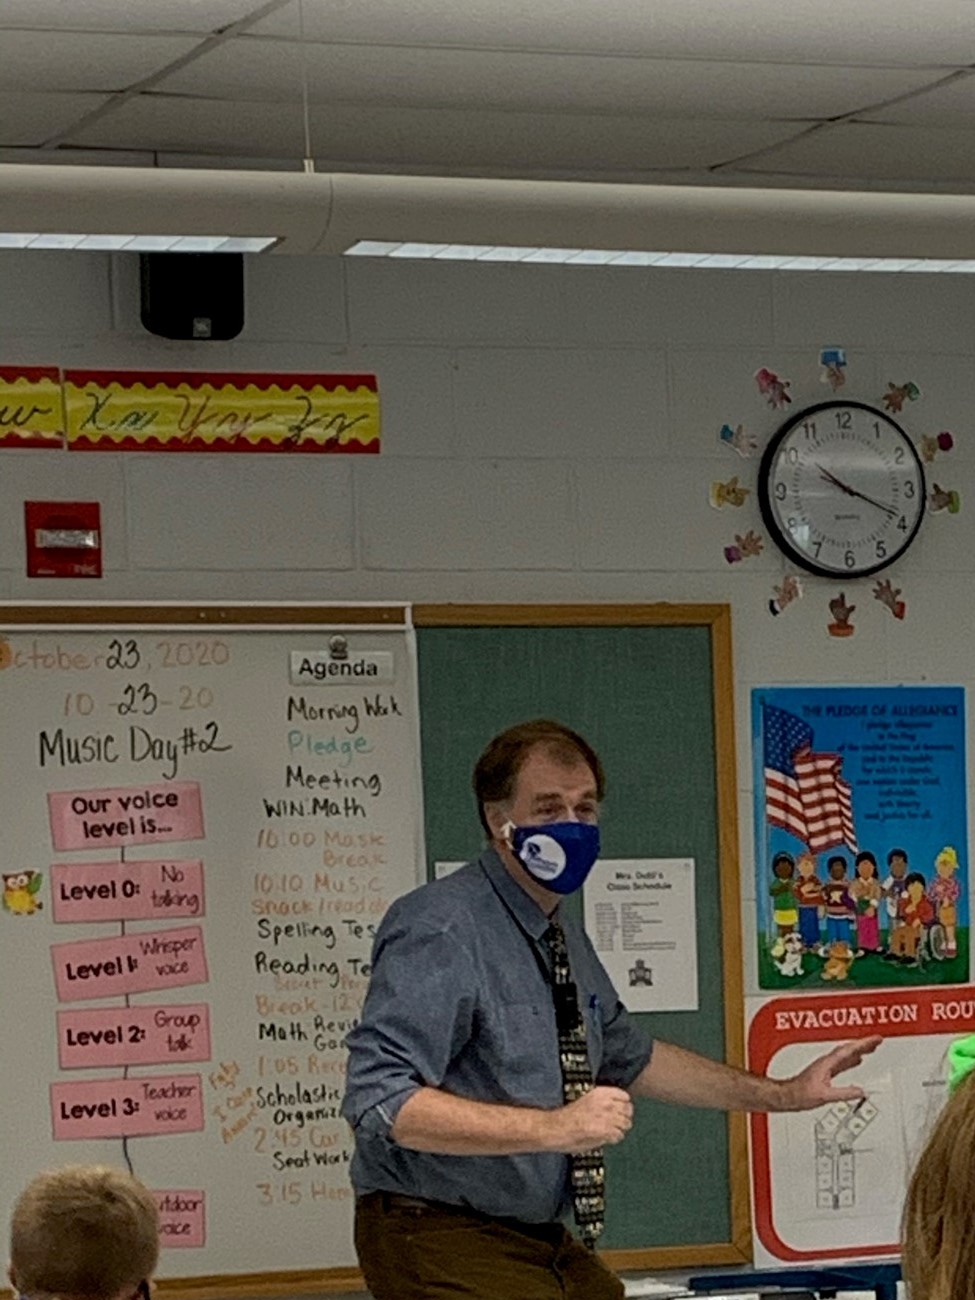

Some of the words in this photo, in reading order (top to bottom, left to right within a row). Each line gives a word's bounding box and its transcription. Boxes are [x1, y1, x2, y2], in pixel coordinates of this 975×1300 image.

[803, 422, 817, 440] 11
[835, 411, 852, 430] 12
[873, 421, 880, 439] 1
[780, 446, 798, 465] 10
[893, 446, 905, 465] 2
[775, 482, 787, 501] 9
[903, 480, 915, 498] 3
[896, 515, 908, 533] 4
[812, 541, 822, 559] 7
[844, 550, 856, 568] 6
[875, 540, 887, 559] 5
[157, 641, 230, 668] 2020
[299, 658, 378, 680] Agenda
[287, 696, 360, 734] Morning
[892, 704, 958, 717] ALLEGIANCE
[39, 728, 118, 767] Music
[287, 730, 375, 768] Pledge
[286, 765, 381, 796] Meeting
[71, 797, 111, 815] Our
[118, 790, 178, 811] voice
[83, 817, 135, 838] level
[161, 865, 184, 883] No
[315, 872, 383, 893] Music
[60, 880, 116, 901] Level
[122, 880, 141, 898] 0:
[257, 918, 336, 949] Spelling
[139, 937, 198, 958] Whisper
[66, 957, 123, 981] Level
[156, 960, 190, 976] voice
[255, 951, 340, 988] Reading
[154, 1010, 200, 1033] Group
[775, 1004, 918, 1031] EVACUATION
[66, 1026, 123, 1046] Level
[128, 1025, 146, 1043] 2:
[259, 1022, 308, 1041] Math
[141, 1083, 197, 1100] Teacher
[256, 1082, 341, 1108] Scholastic
[60, 1099, 116, 1120] Level
[122, 1098, 140, 1116] 3:
[154, 1106, 187, 1122] voice
[273, 1150, 311, 1171] Seat
[313, 1150, 350, 1167] Work
